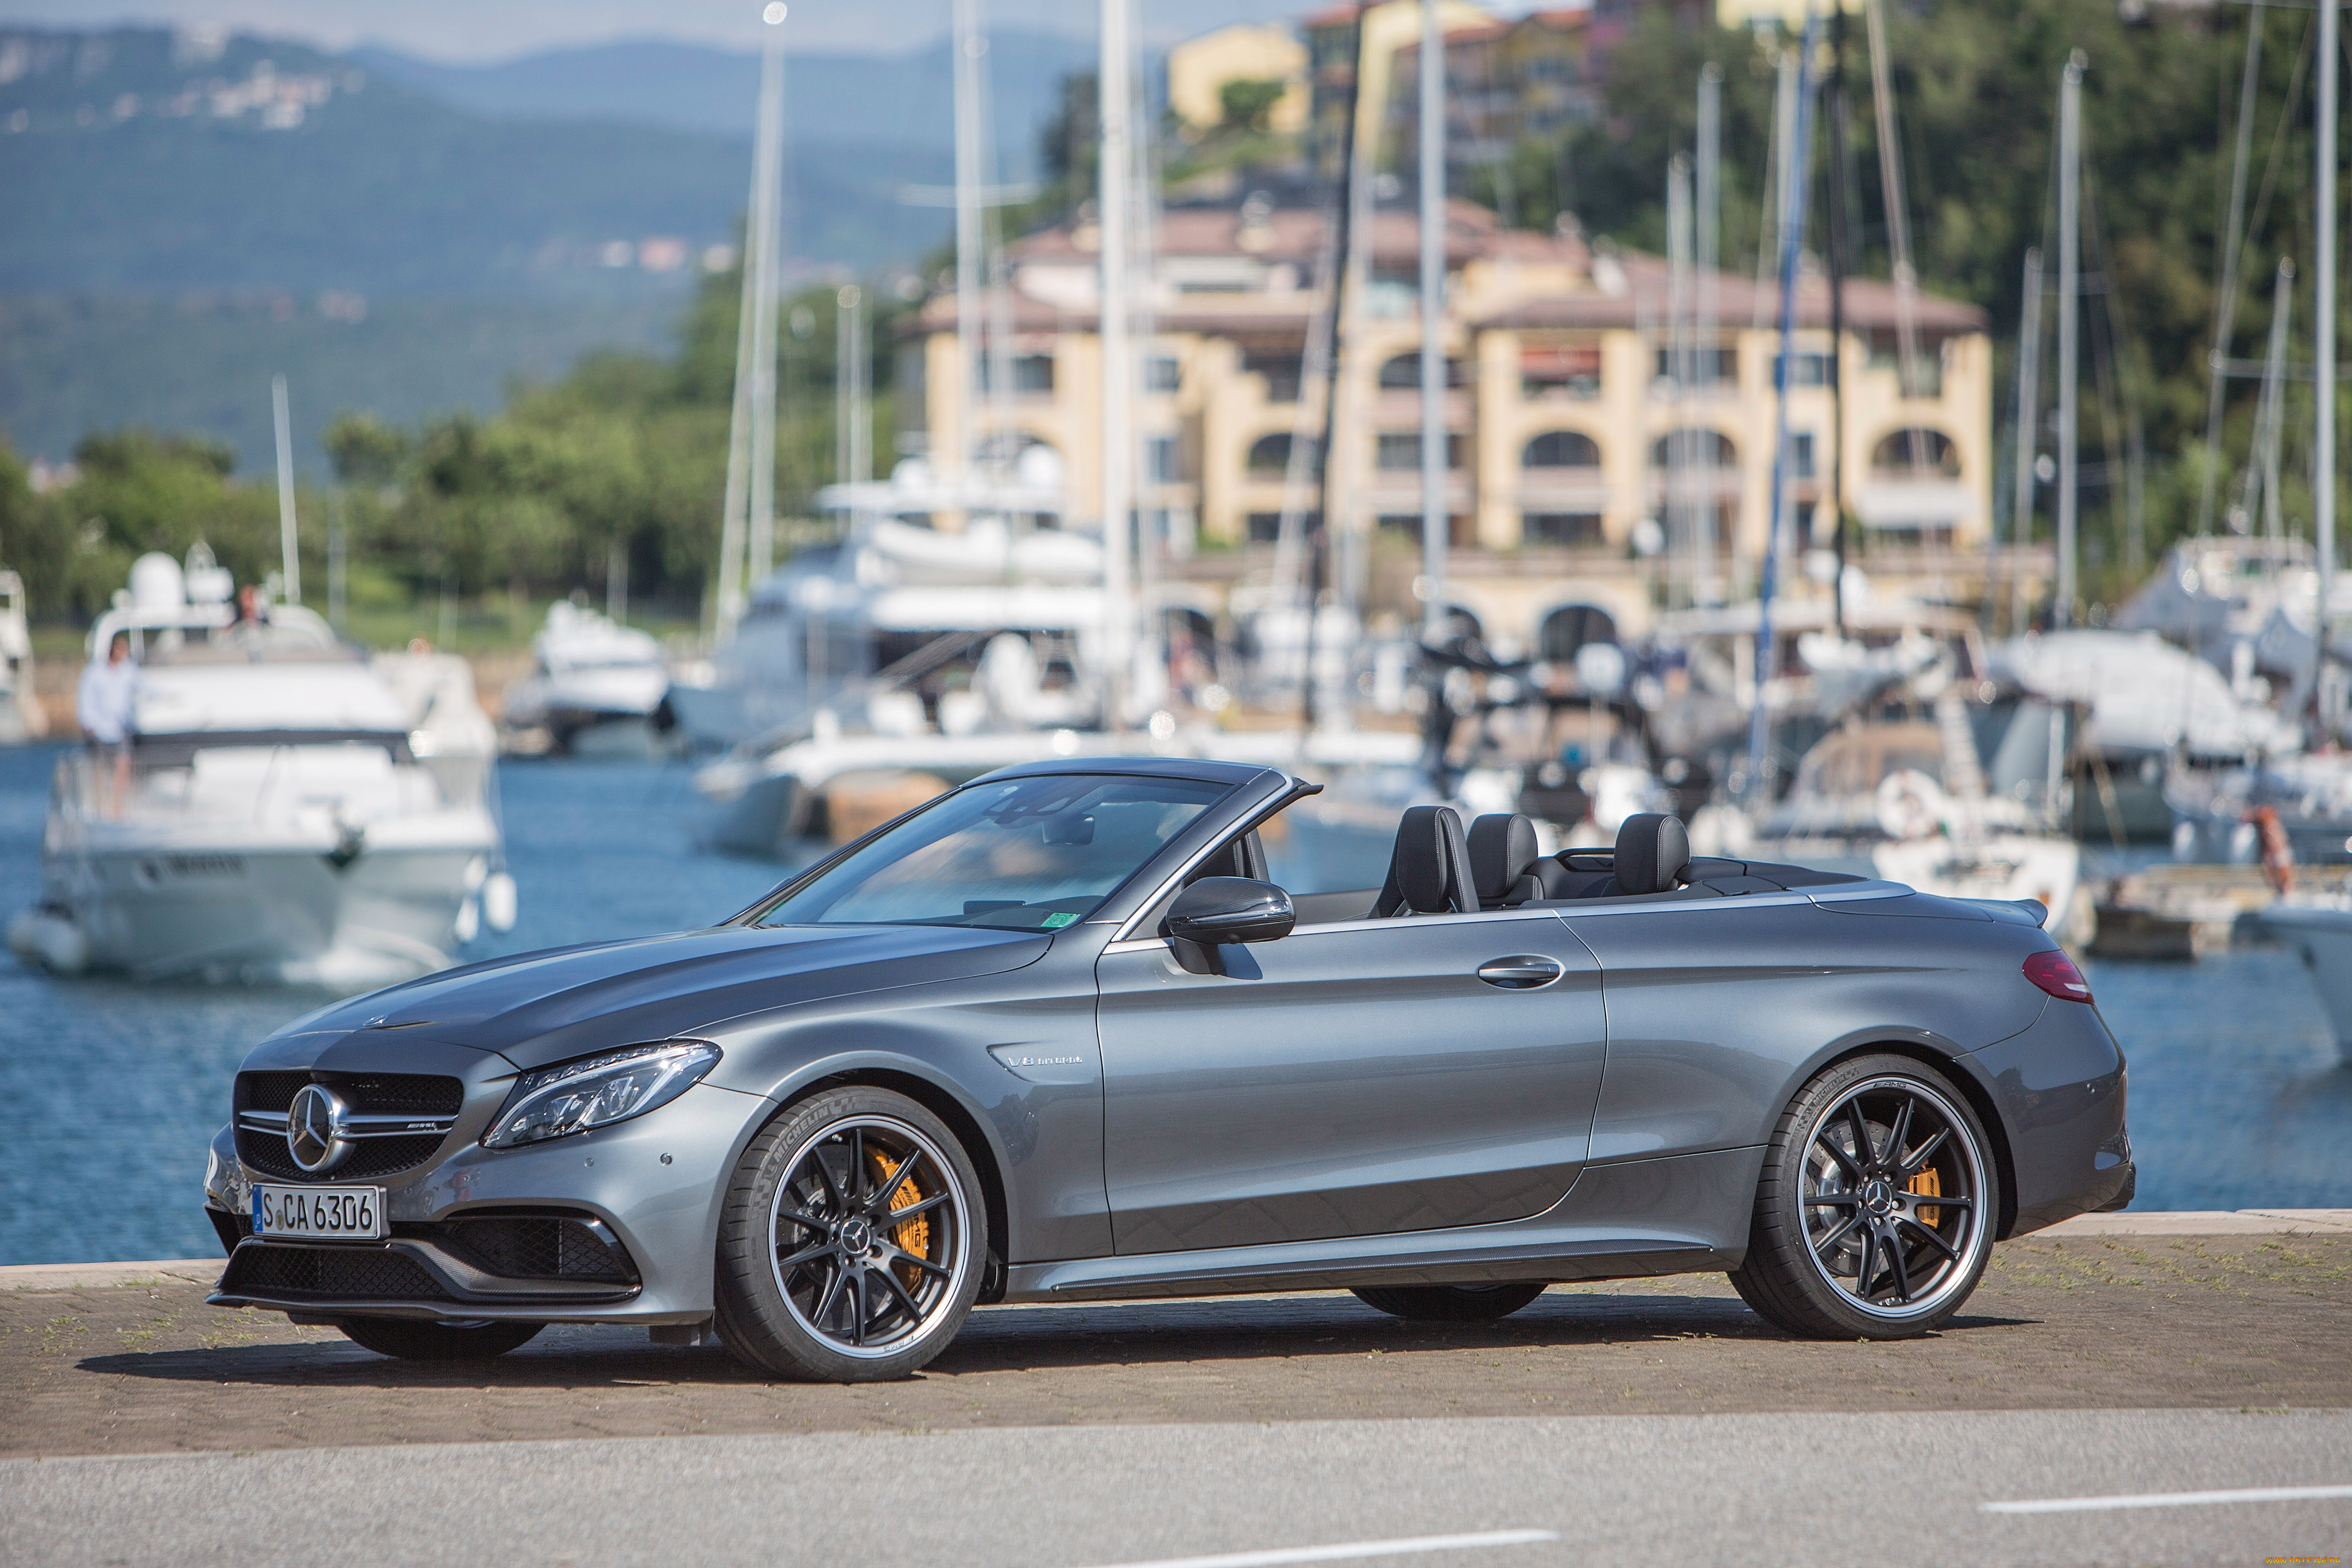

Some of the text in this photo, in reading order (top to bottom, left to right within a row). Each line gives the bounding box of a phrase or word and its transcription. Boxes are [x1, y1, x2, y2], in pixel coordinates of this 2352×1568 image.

[1008, 1057, 1034, 1067] V8
[1813, 1073, 1847, 1106] MICHELIN
[773, 1105, 829, 1163] MICHELIN
[263, 1193, 372, 1230] S CA 6306
